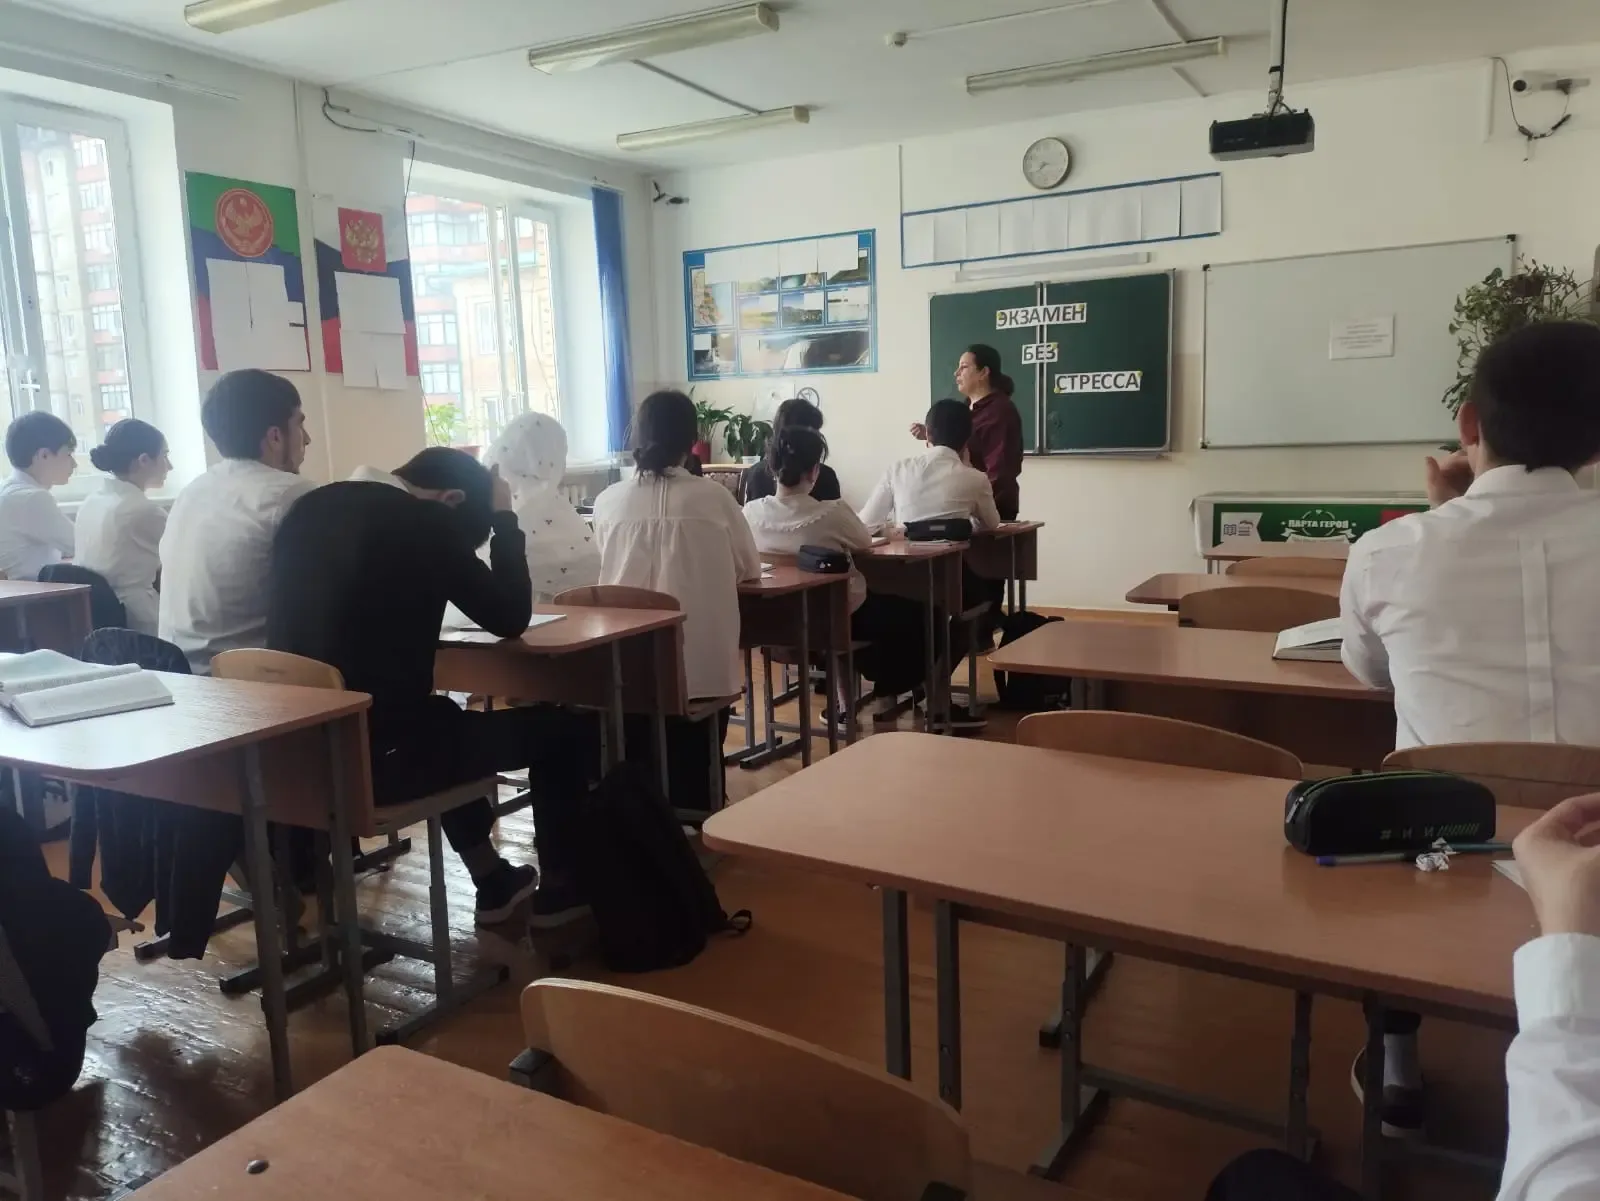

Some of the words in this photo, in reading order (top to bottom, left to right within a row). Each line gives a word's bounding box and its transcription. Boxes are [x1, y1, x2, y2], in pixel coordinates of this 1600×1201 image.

[997, 305, 1085, 327] ЭКЗАМЕН
[1023, 344, 1056, 361] БЕЗ
[1056, 372, 1139, 391] СТРЕССА
[1288, 519, 1318, 528] ПАРТА
